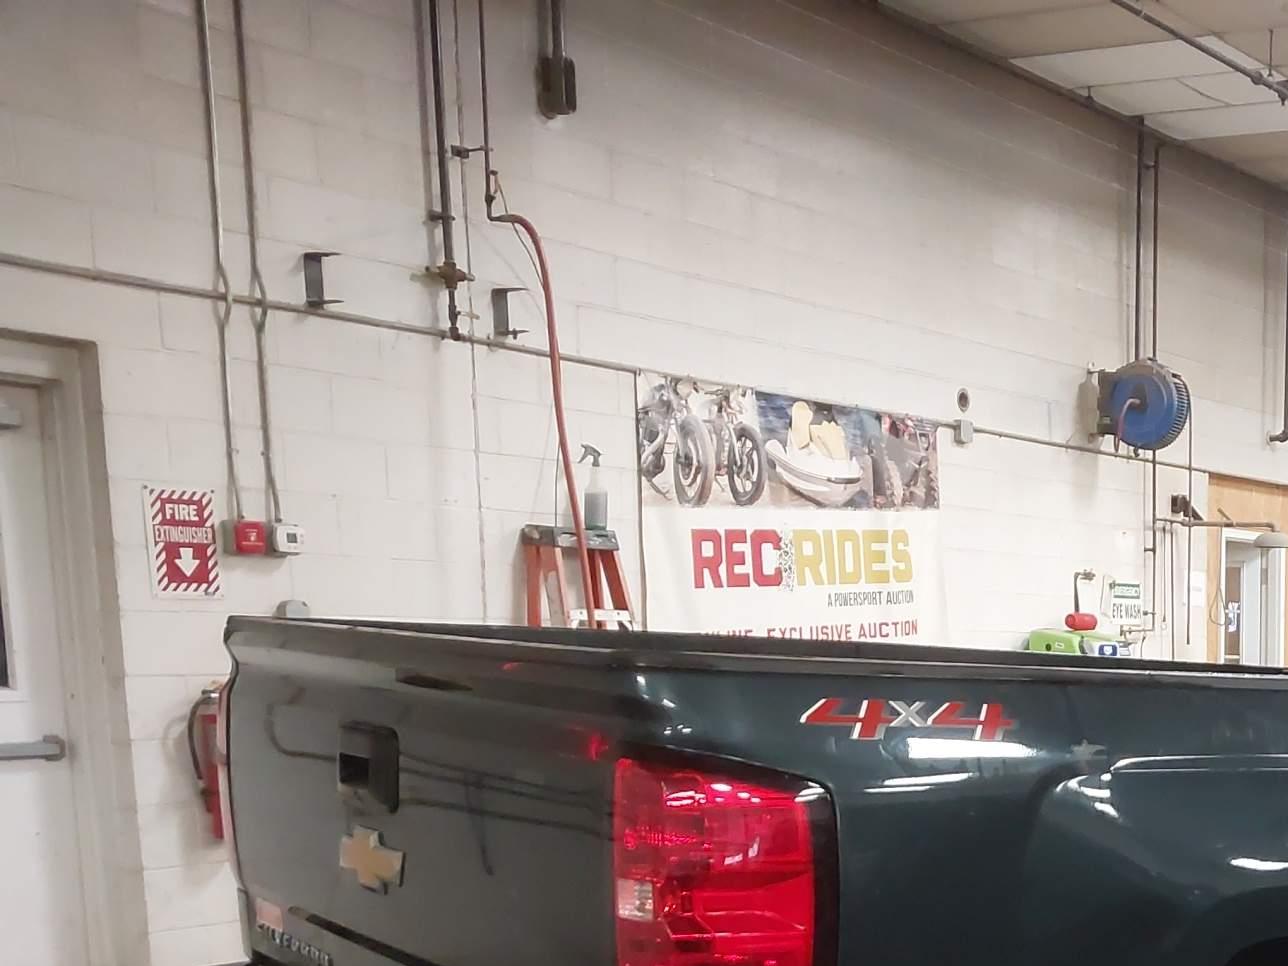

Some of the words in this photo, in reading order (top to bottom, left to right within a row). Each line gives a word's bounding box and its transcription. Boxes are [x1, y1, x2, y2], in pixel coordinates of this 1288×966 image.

[165, 503, 199, 521] FIRE
[155, 526, 214, 544] EXTINGUISHER
[691, 529, 783, 588] REC
[793, 529, 913, 586] RIDES
[827, 592, 833, 607] A
[834, 591, 882, 607] POWERSPORT
[886, 590, 914, 606] AUCTION
[1112, 602, 1123, 619] EYE
[1125, 602, 1142, 620] WASH
[858, 619, 918, 639] AUCTION
